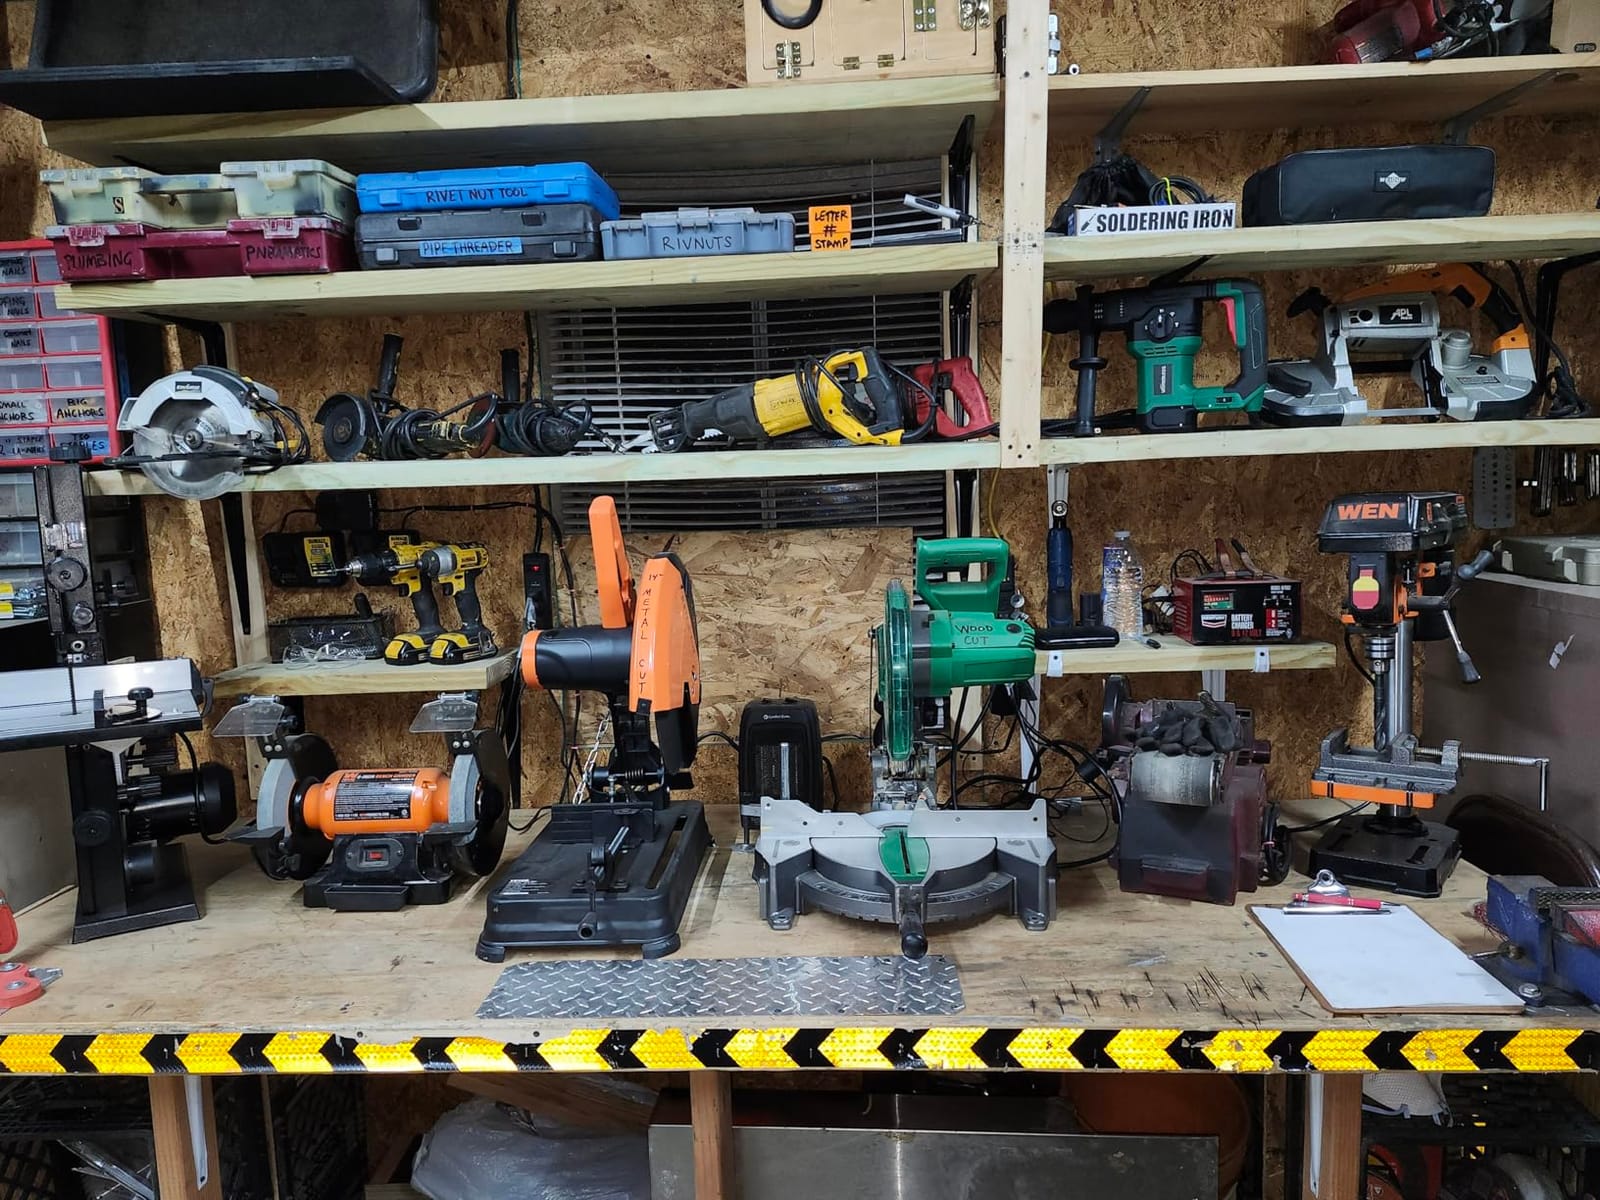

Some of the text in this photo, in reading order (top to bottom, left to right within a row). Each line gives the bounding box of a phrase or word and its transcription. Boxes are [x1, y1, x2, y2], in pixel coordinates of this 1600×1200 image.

[426, 187, 528, 203] RIVET NUT TOOL
[113, 197, 125, 214] S
[815, 209, 849, 221] LETTER
[1097, 209, 1234, 233] SOLDERING IRON
[823, 225, 837, 238] #
[423, 240, 513, 255] PIPE THREADER
[662, 236, 733, 252] RIVNUTS
[815, 238, 849, 249] STAMP
[65, 251, 132, 270] PLUMBING
[66, 397, 88, 407] BIG
[56, 407, 105, 420] ANCHORS
[1338, 502, 1399, 520] WEN
[641, 588, 652, 640] METAL
[955, 625, 993, 634] WOOD
[964, 635, 989, 646] CUT
[638, 658, 647, 696] CUT
